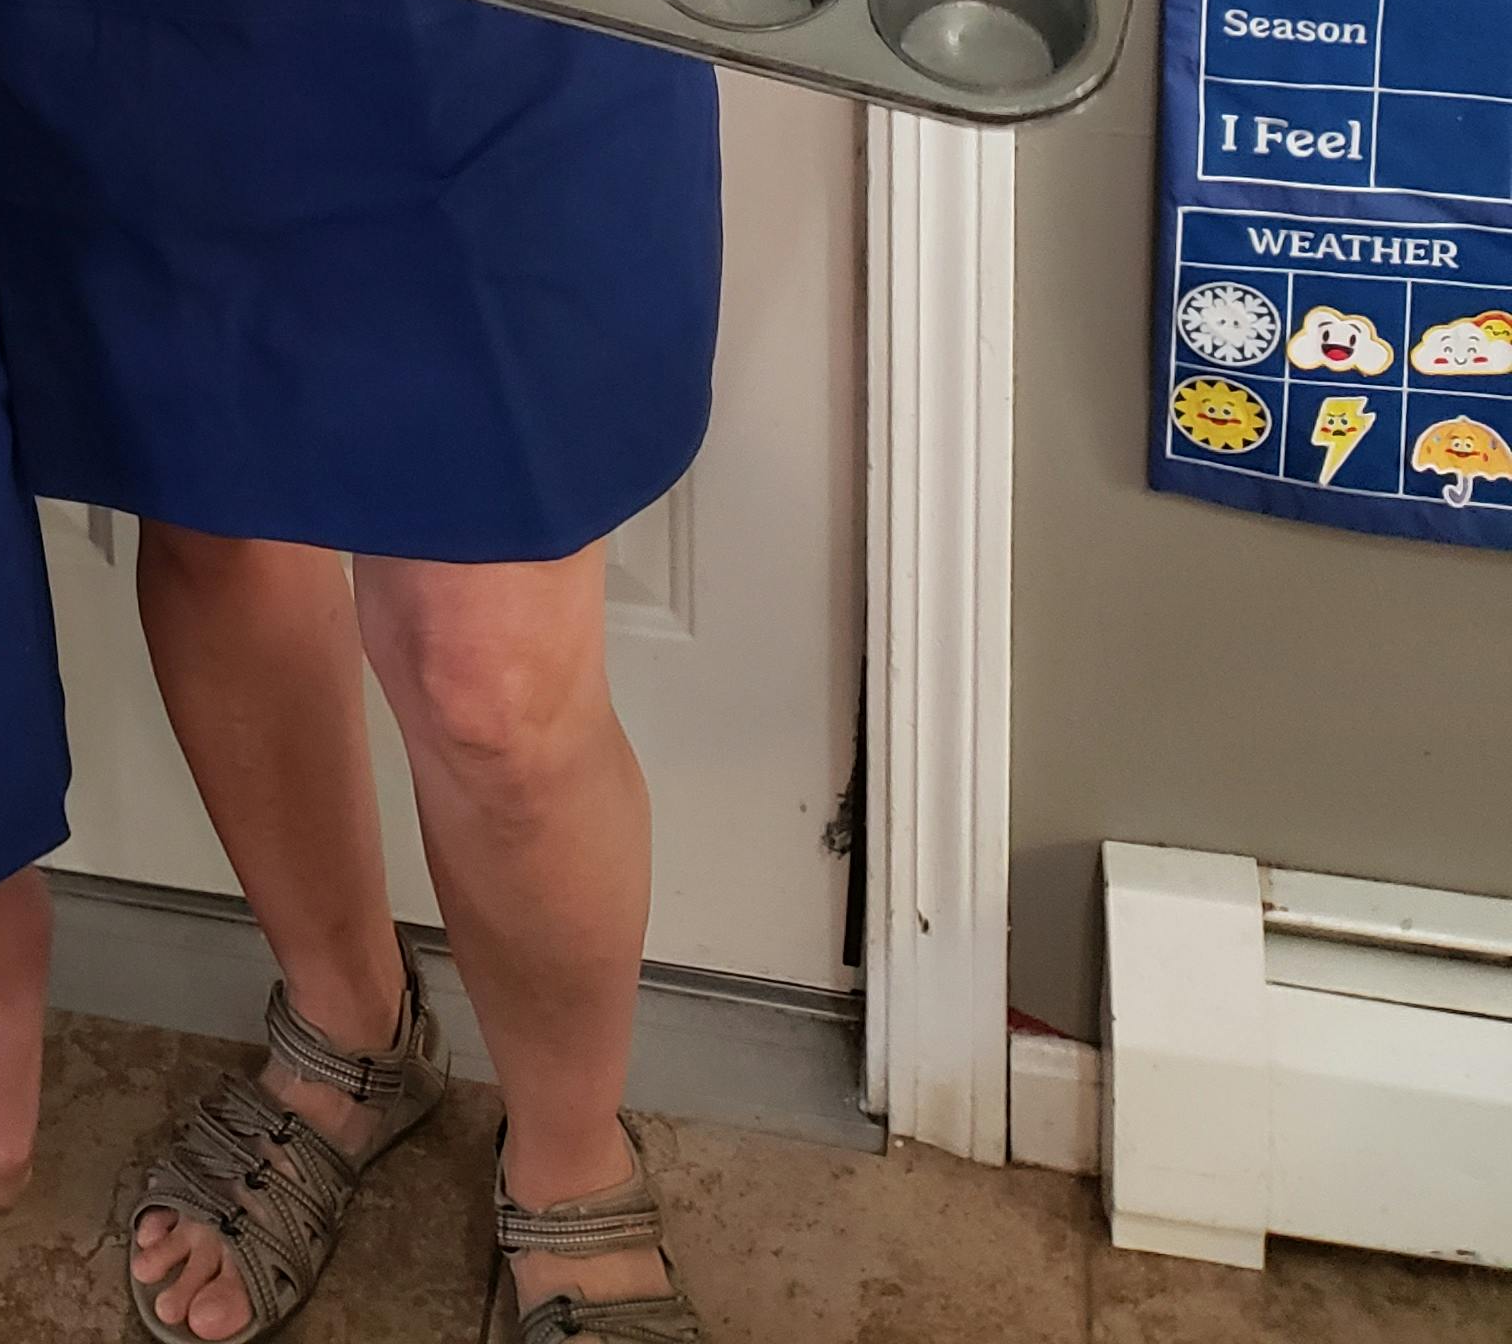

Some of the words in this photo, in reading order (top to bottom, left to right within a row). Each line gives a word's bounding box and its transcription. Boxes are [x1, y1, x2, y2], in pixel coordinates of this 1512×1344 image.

[1223, 9, 1368, 45] Season
[1221, 114, 1237, 152] I
[1253, 116, 1363, 160] Feel
[1247, 226, 1459, 269] WEATHER
